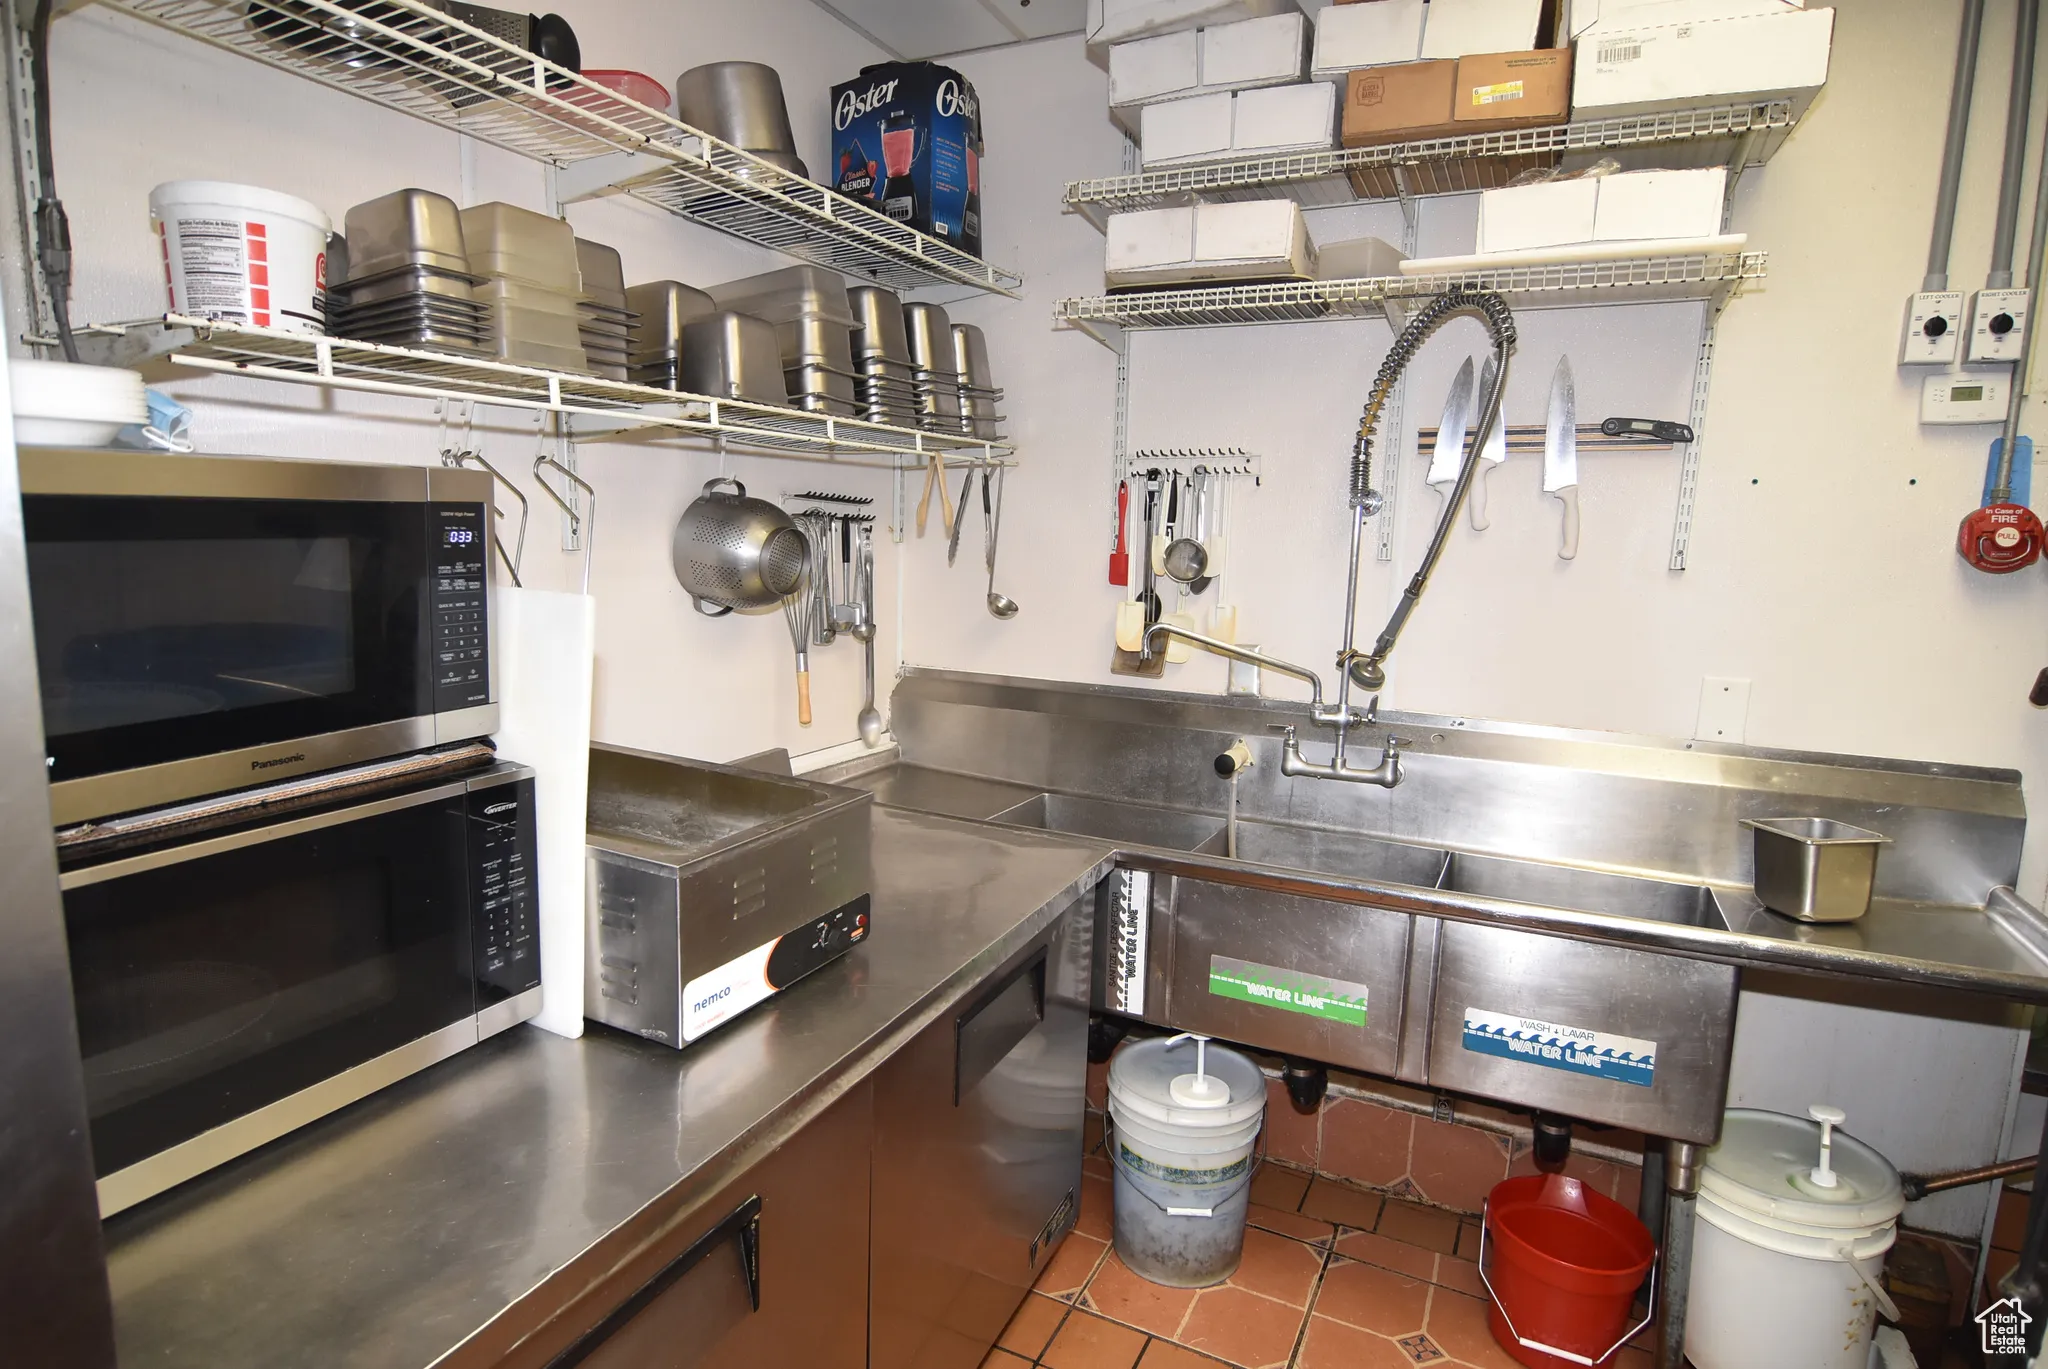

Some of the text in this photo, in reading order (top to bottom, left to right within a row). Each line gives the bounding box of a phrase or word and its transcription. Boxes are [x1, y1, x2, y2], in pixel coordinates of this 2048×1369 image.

[834, 78, 899, 131] Oster
[935, 79, 977, 121] Oster
[841, 177, 871, 192] BLENDER
[845, 168, 867, 182] Classic
[1991, 515, 2018, 523] FIRE
[1997, 532, 2018, 540] PULL
[251, 752, 305, 771] Panasonic
[487, 802, 517, 814] INVERTER
[1109, 891, 1119, 988] SANITIZE DESINFECTAR
[1125, 909, 1139, 978] WATER LINE
[693, 986, 731, 1013] nemco
[1246, 982, 1325, 1010] WATER LINE
[1519, 1019, 1595, 1042] WASH LAVAR
[1507, 1037, 1602, 1069] WATER LINE
